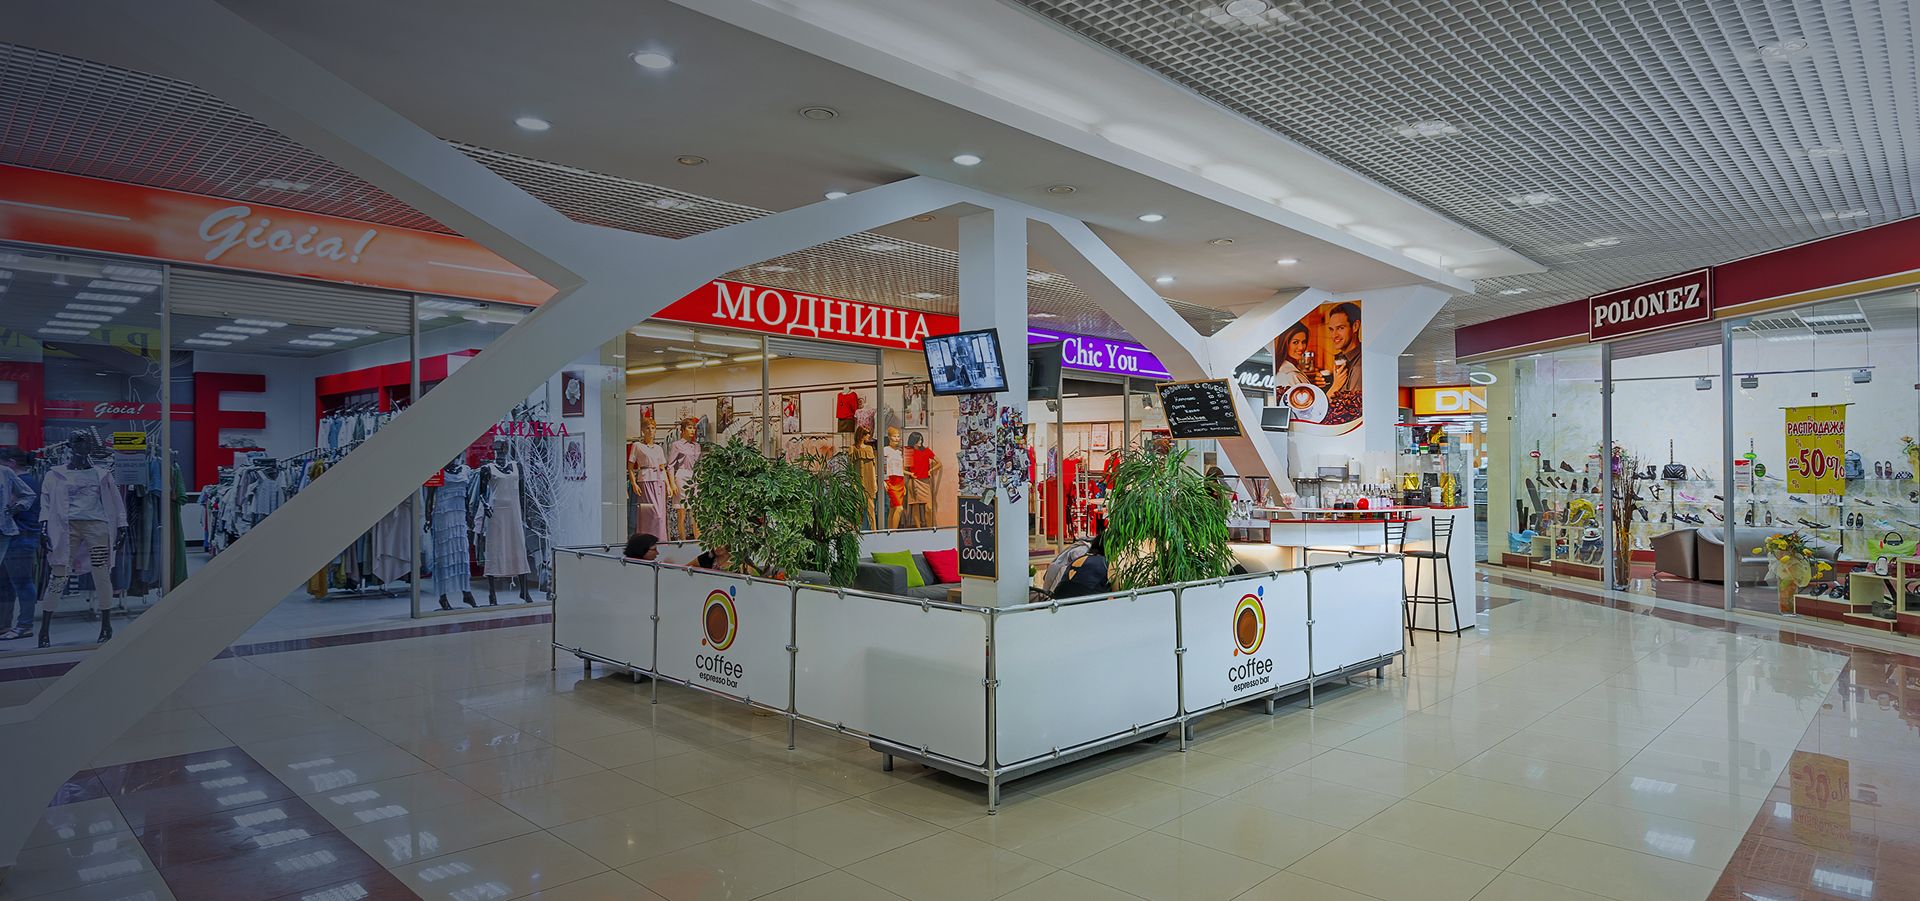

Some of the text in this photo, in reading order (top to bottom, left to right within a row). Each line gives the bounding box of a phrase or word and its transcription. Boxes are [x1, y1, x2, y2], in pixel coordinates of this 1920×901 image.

[199, 205, 378, 264] Gioia!
[712, 281, 930, 349] МОДНИЦА
[1594, 283, 1700, 328] POLONEZ
[1062, 337, 1138, 372] Chic You
[93, 402, 145, 418] Gioia!
[491, 420, 570, 439] КИДКА
[1787, 420, 1845, 437] РАСПРОДАЖА
[695, 654, 743, 679] coffee
[1228, 657, 1273, 682] coffee
[699, 671, 738, 689] espresso bar
[1233, 674, 1270, 692] espresso bar
